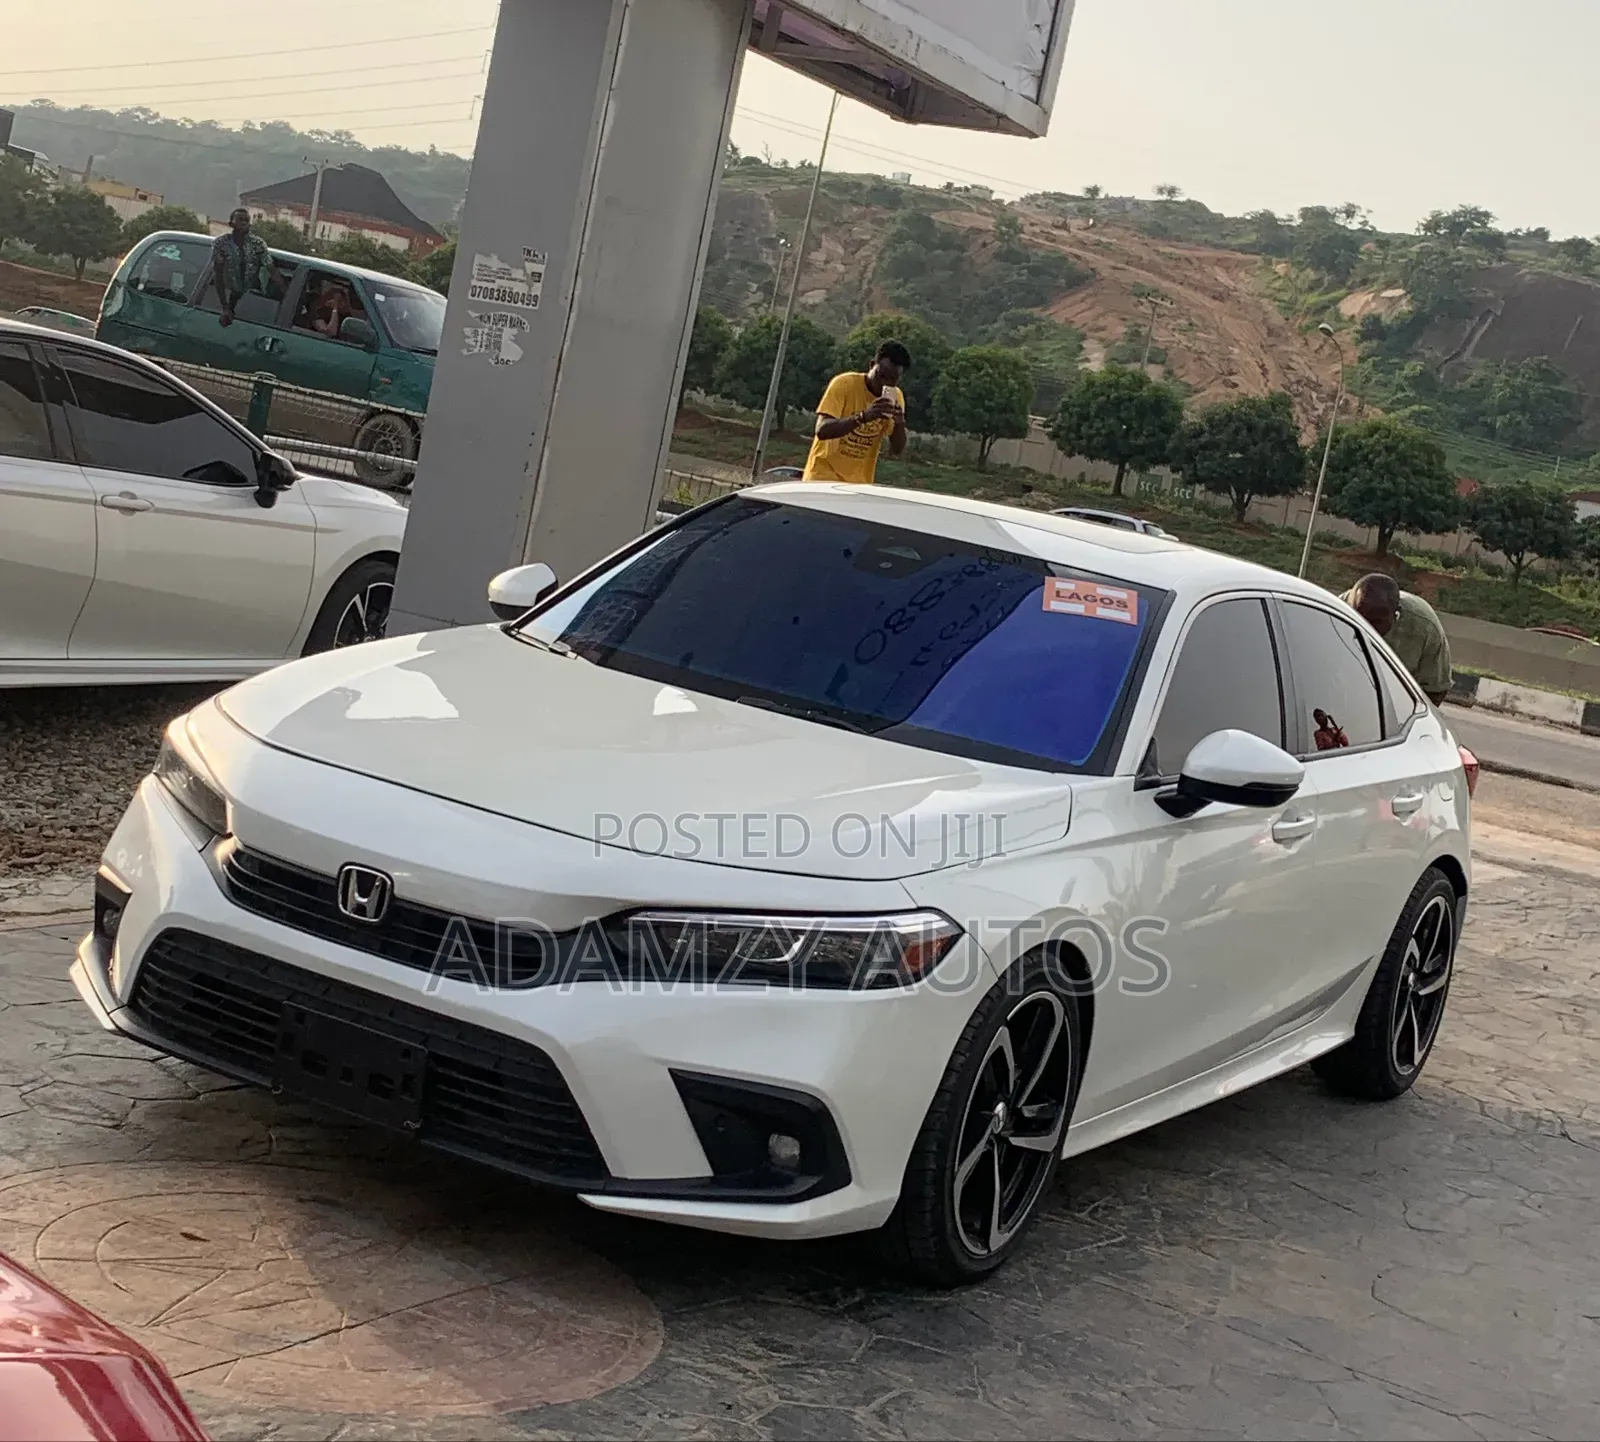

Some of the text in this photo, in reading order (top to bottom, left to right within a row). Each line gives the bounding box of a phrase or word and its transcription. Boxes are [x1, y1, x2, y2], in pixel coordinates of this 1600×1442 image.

[470, 285, 539, 307] 07083890499
[1173, 487, 1193, 499] SCC
[1055, 590, 1129, 609] LAGOS
